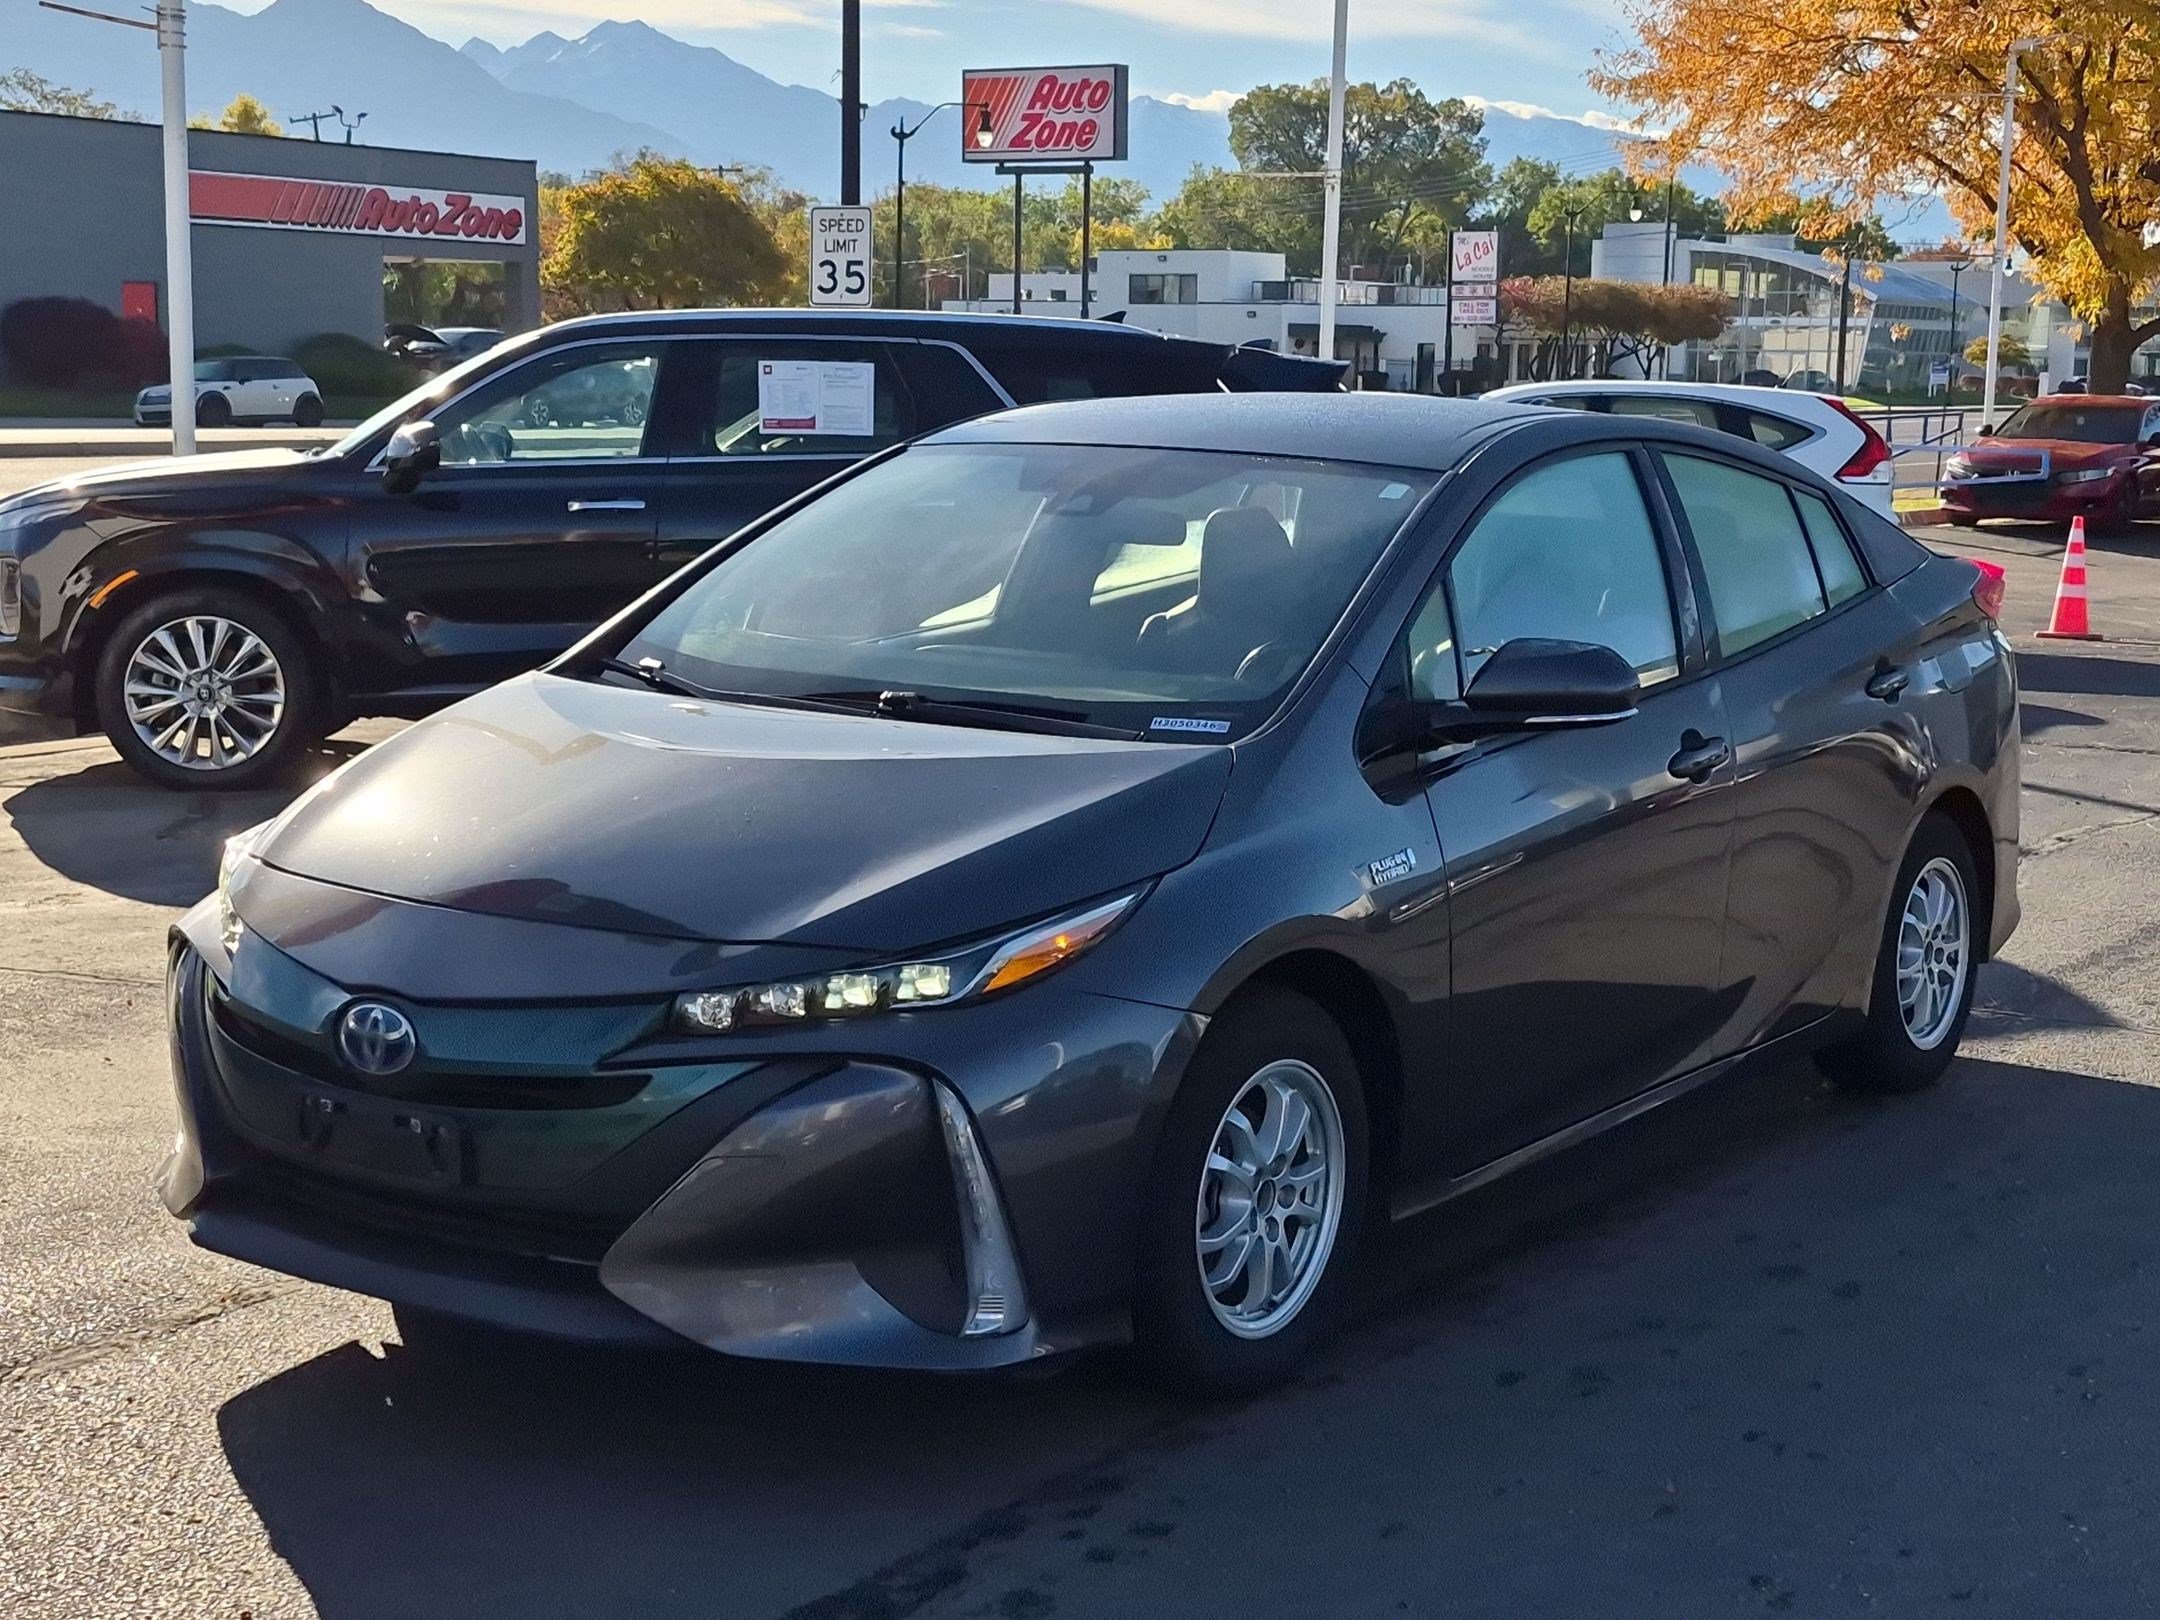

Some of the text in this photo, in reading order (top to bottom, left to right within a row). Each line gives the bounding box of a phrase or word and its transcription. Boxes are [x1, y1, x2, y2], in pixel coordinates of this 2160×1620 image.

[1027, 74, 1111, 111] Auto
[1008, 112, 1098, 150] Zone
[354, 187, 523, 241] AutoZone
[819, 218, 865, 233] SPEED
[824, 238, 858, 253] LIMIT
[1455, 233, 1494, 271] La Cai
[817, 259, 865, 295] 35
[1373, 863, 1410, 885] HYBRID
